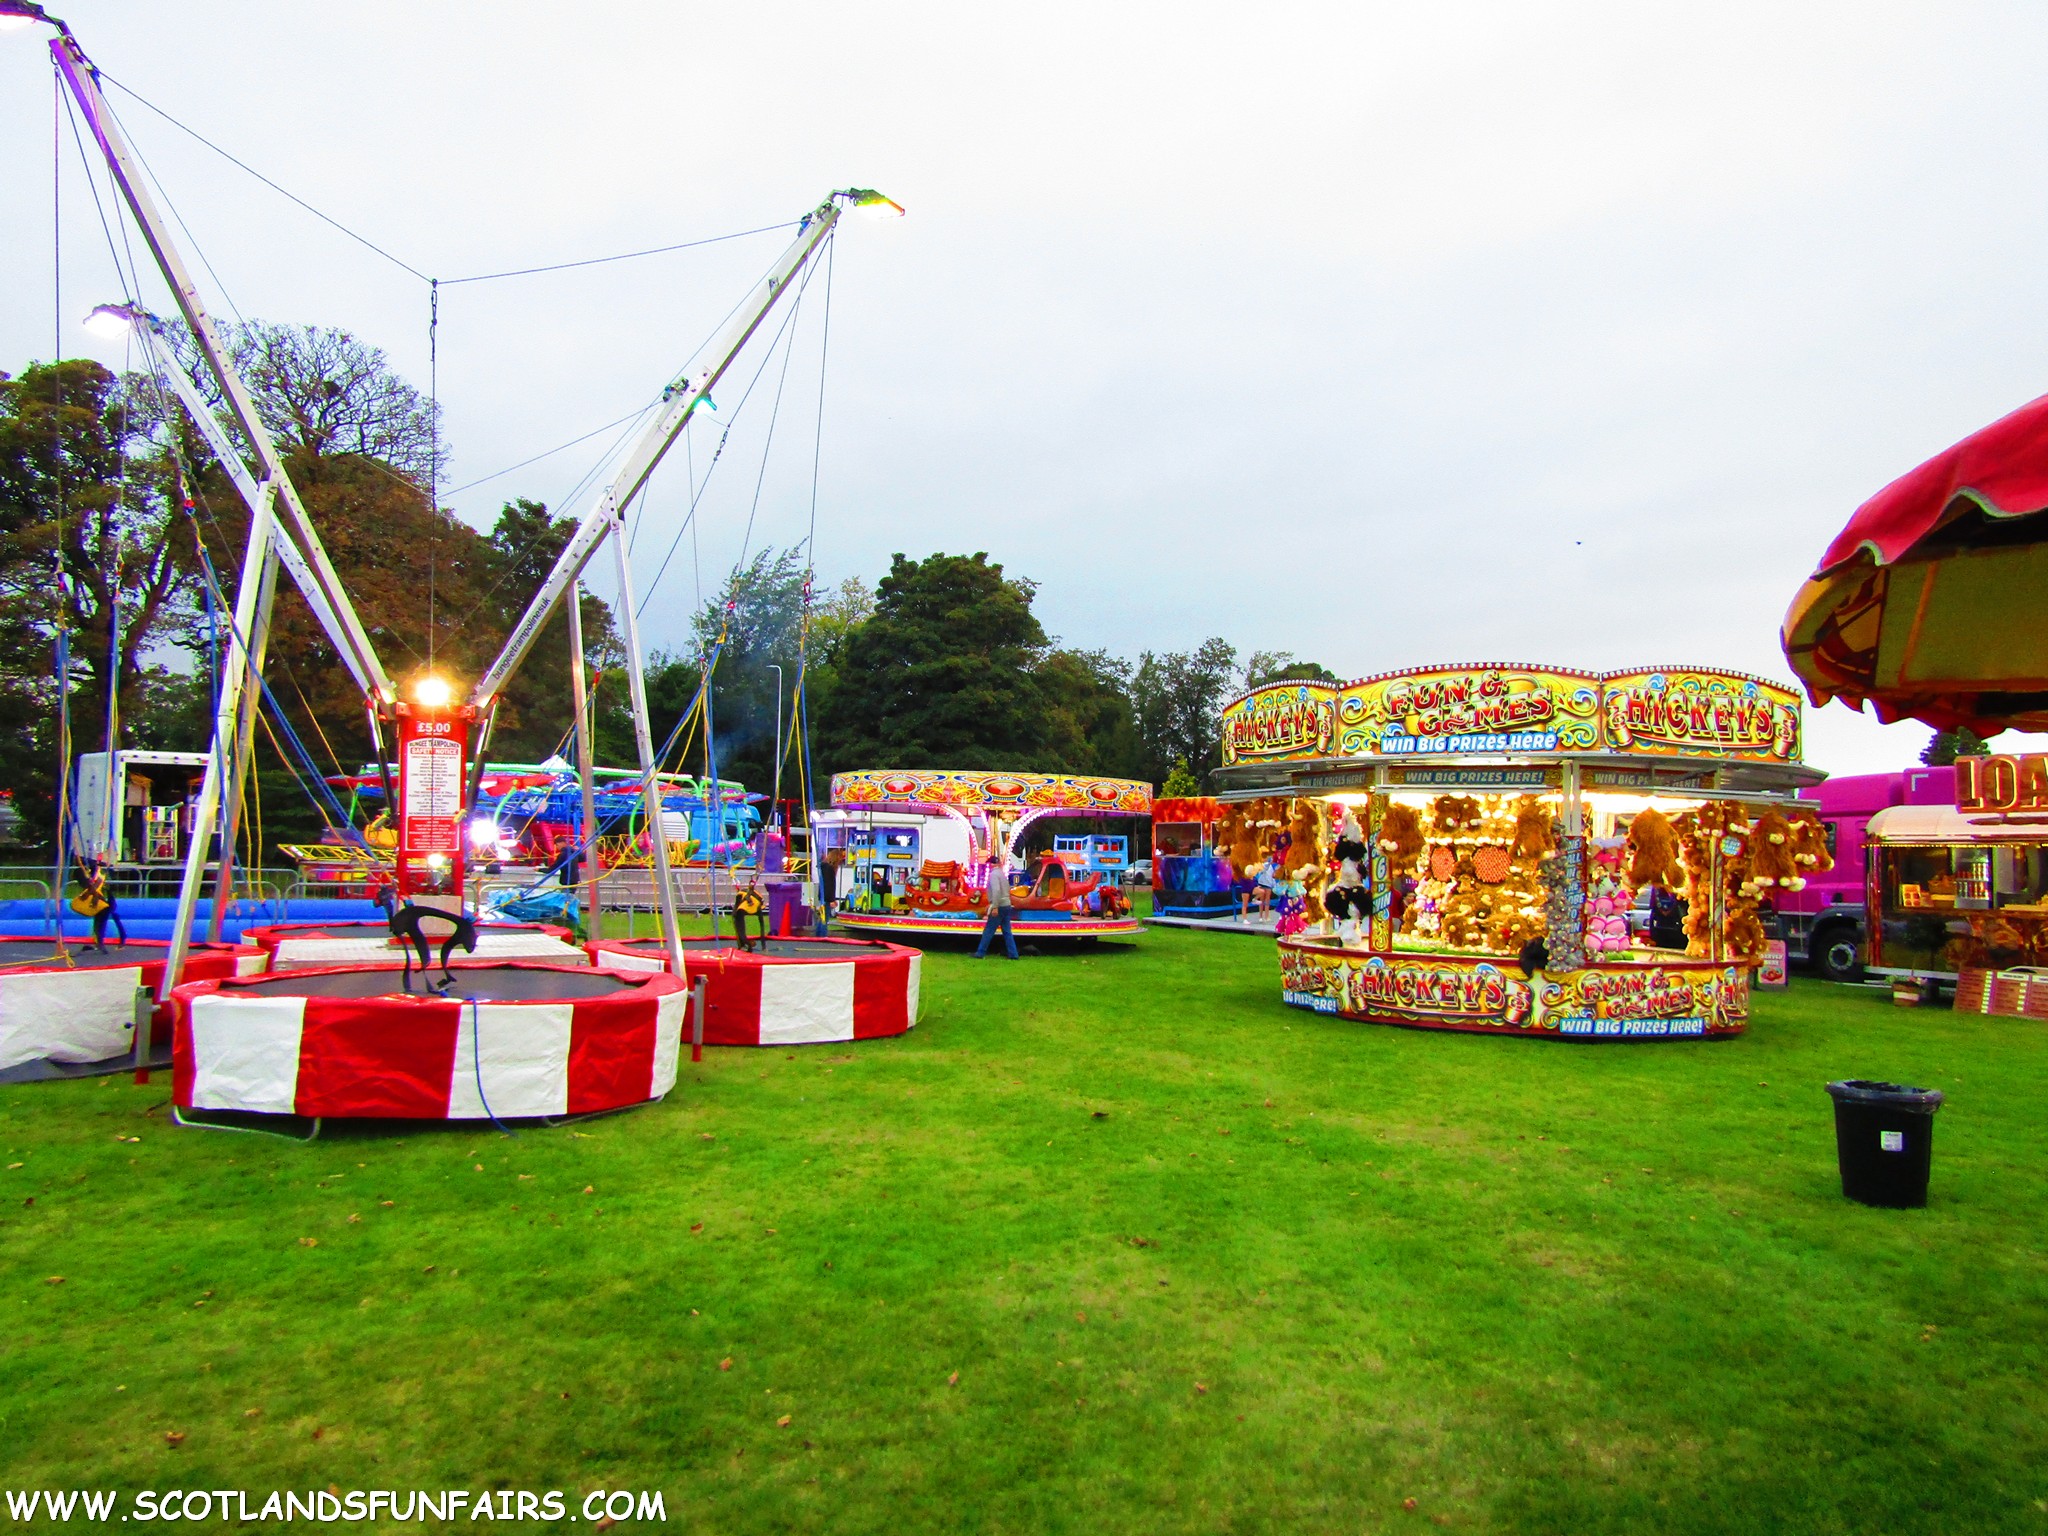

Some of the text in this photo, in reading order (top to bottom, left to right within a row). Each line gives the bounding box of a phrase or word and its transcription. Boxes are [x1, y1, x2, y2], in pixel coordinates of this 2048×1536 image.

[1388, 669, 1508, 718] FUN &
[1417, 688, 1554, 738] GAMES
[417, 722, 451, 733] £5.00
[1382, 737, 1415, 751] WIN
[1418, 736, 1446, 751] BIG
[1449, 735, 1506, 751] PRIZES
[1406, 771, 1543, 782] WIN BIG PRIZES HERE!
[1595, 773, 1617, 784] WIN
[1618, 774, 1636, 785] BIG
[1582, 967, 1669, 1003] FUN &
[1606, 985, 1693, 1019] GAMES
[1561, 1020, 1593, 1033] WIN
[1594, 1020, 1620, 1033] BIG
[1623, 1020, 1667, 1034] PRIZES
